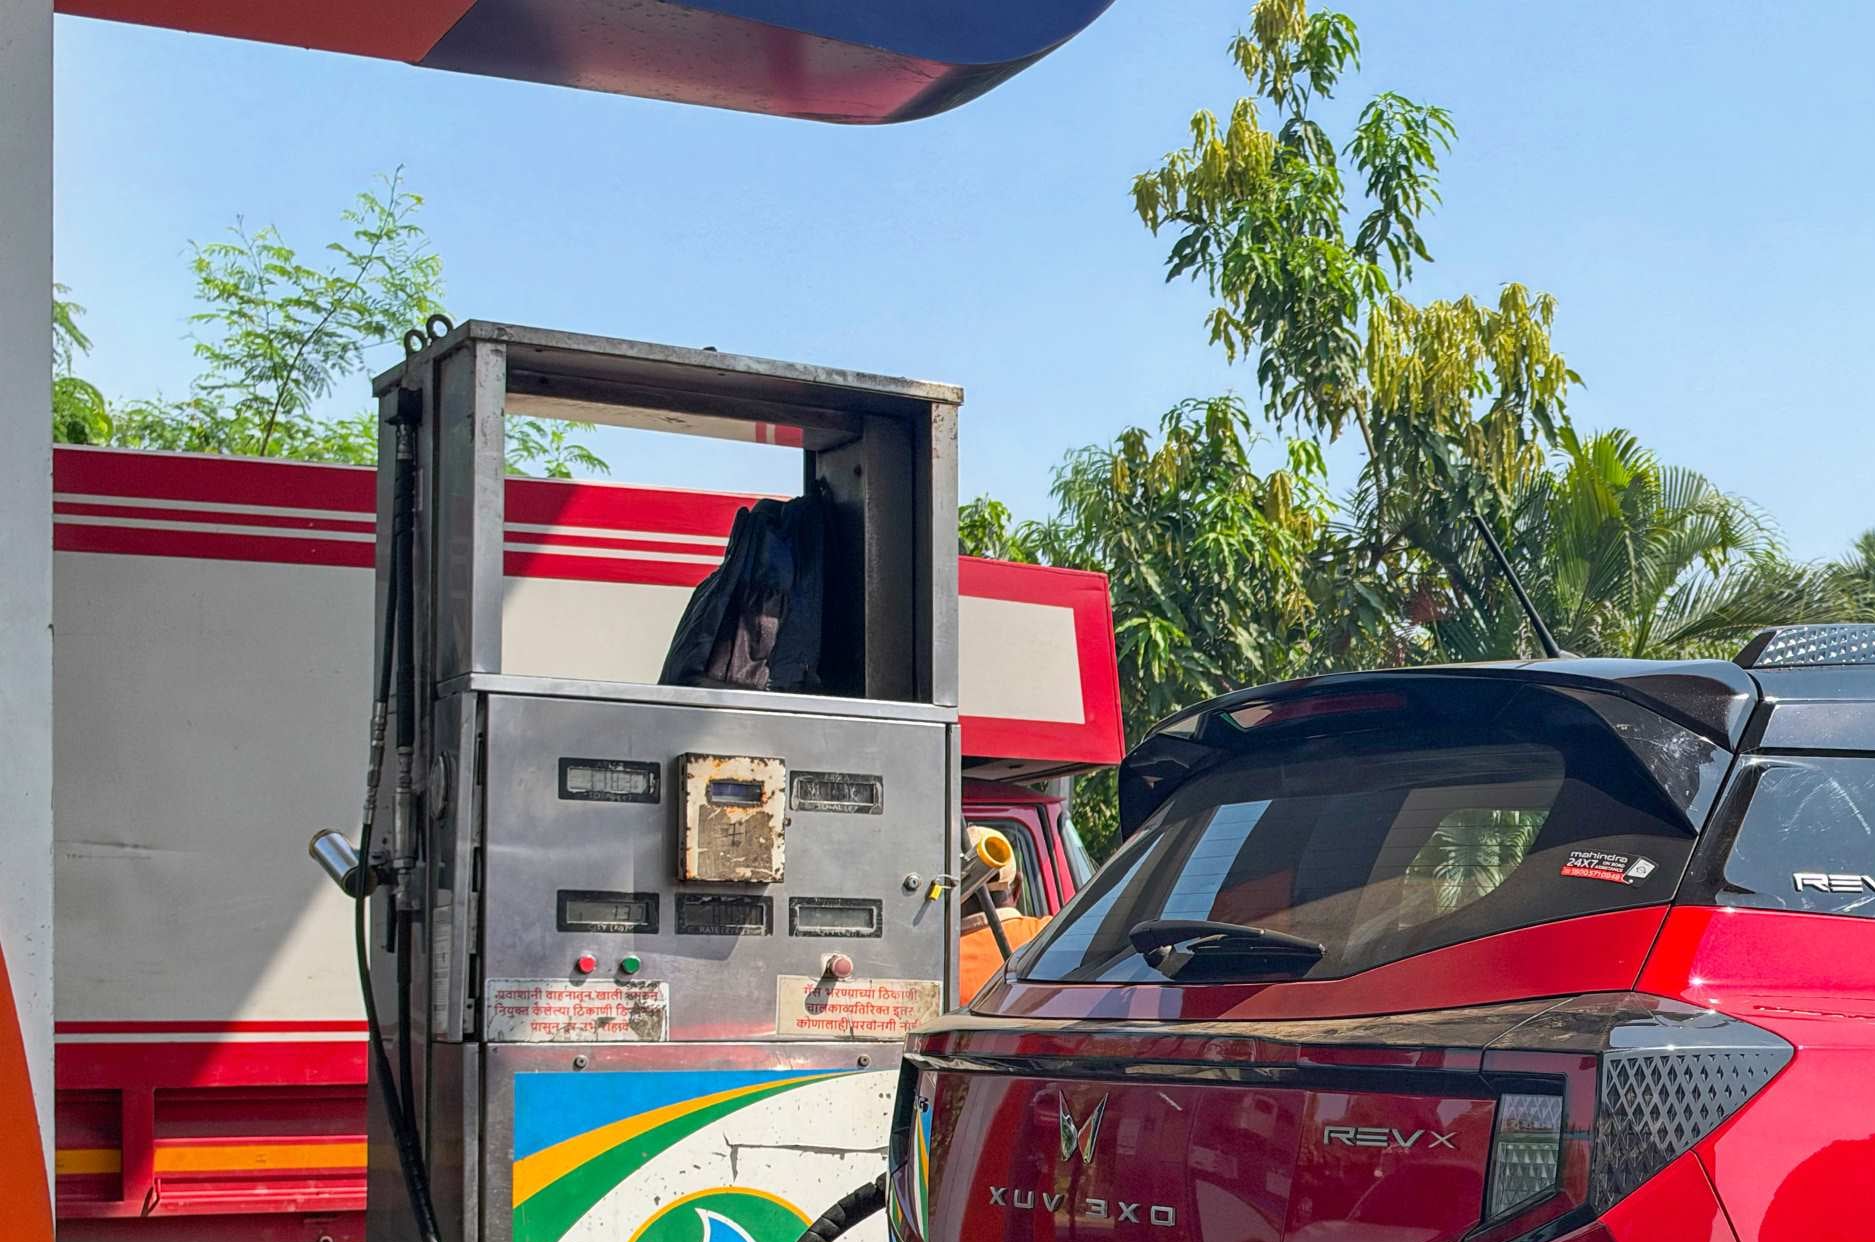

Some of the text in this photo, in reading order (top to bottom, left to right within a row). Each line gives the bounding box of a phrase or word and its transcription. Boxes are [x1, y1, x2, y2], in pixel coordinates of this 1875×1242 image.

[1567, 858, 1599, 868] 24X7
[1570, 851, 1628, 863] mahindra
[573, 1003, 613, 1017] ठिकाणी
[988, 1185, 1066, 1213] XUV
